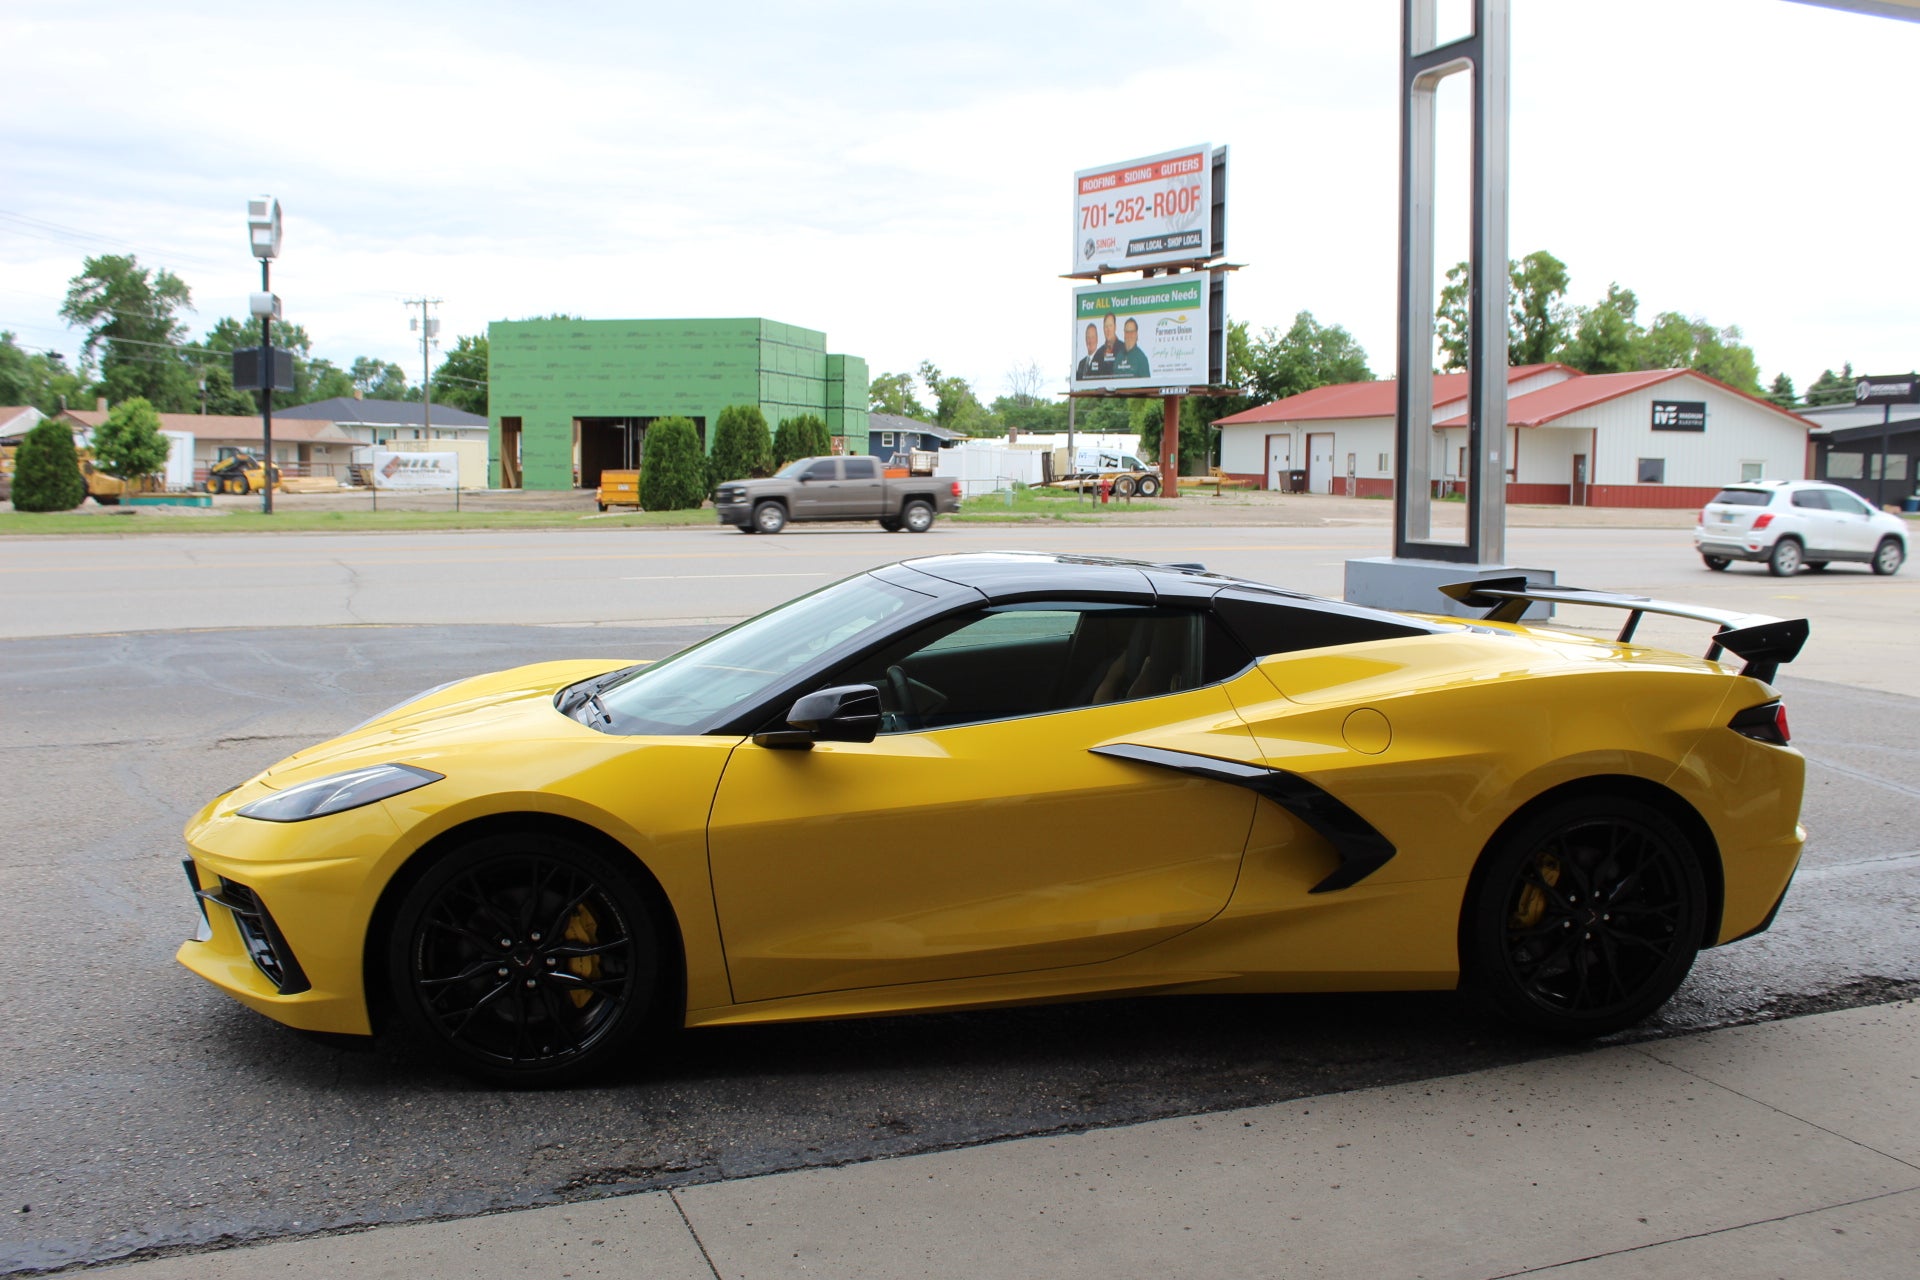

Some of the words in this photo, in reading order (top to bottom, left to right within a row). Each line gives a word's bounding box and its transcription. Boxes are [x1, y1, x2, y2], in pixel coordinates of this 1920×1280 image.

[1082, 175, 1116, 192] ROOFING
[1124, 167, 1152, 183] SIDING
[1161, 157, 1199, 175] GUTTERS
[1081, 186, 1201, 230] 701-252-ROOF
[1095, 237, 1116, 249] SINGH
[1130, 240, 1146, 253] THINK
[1145, 239, 1163, 251] LOCAL
[1167, 236, 1183, 249] SHOP
[1183, 233, 1201, 246] LOCAL
[1081, 299, 1094, 310] For
[1095, 298, 1111, 309] ALL
[1111, 296, 1129, 308] Your
[1130, 292, 1170, 305] Insurance
[1171, 288, 1198, 301] Needs
[1155, 327, 1176, 336] Farmers
[1177, 325, 1193, 335] Union
[1155, 335, 1193, 343] INSURANCE
